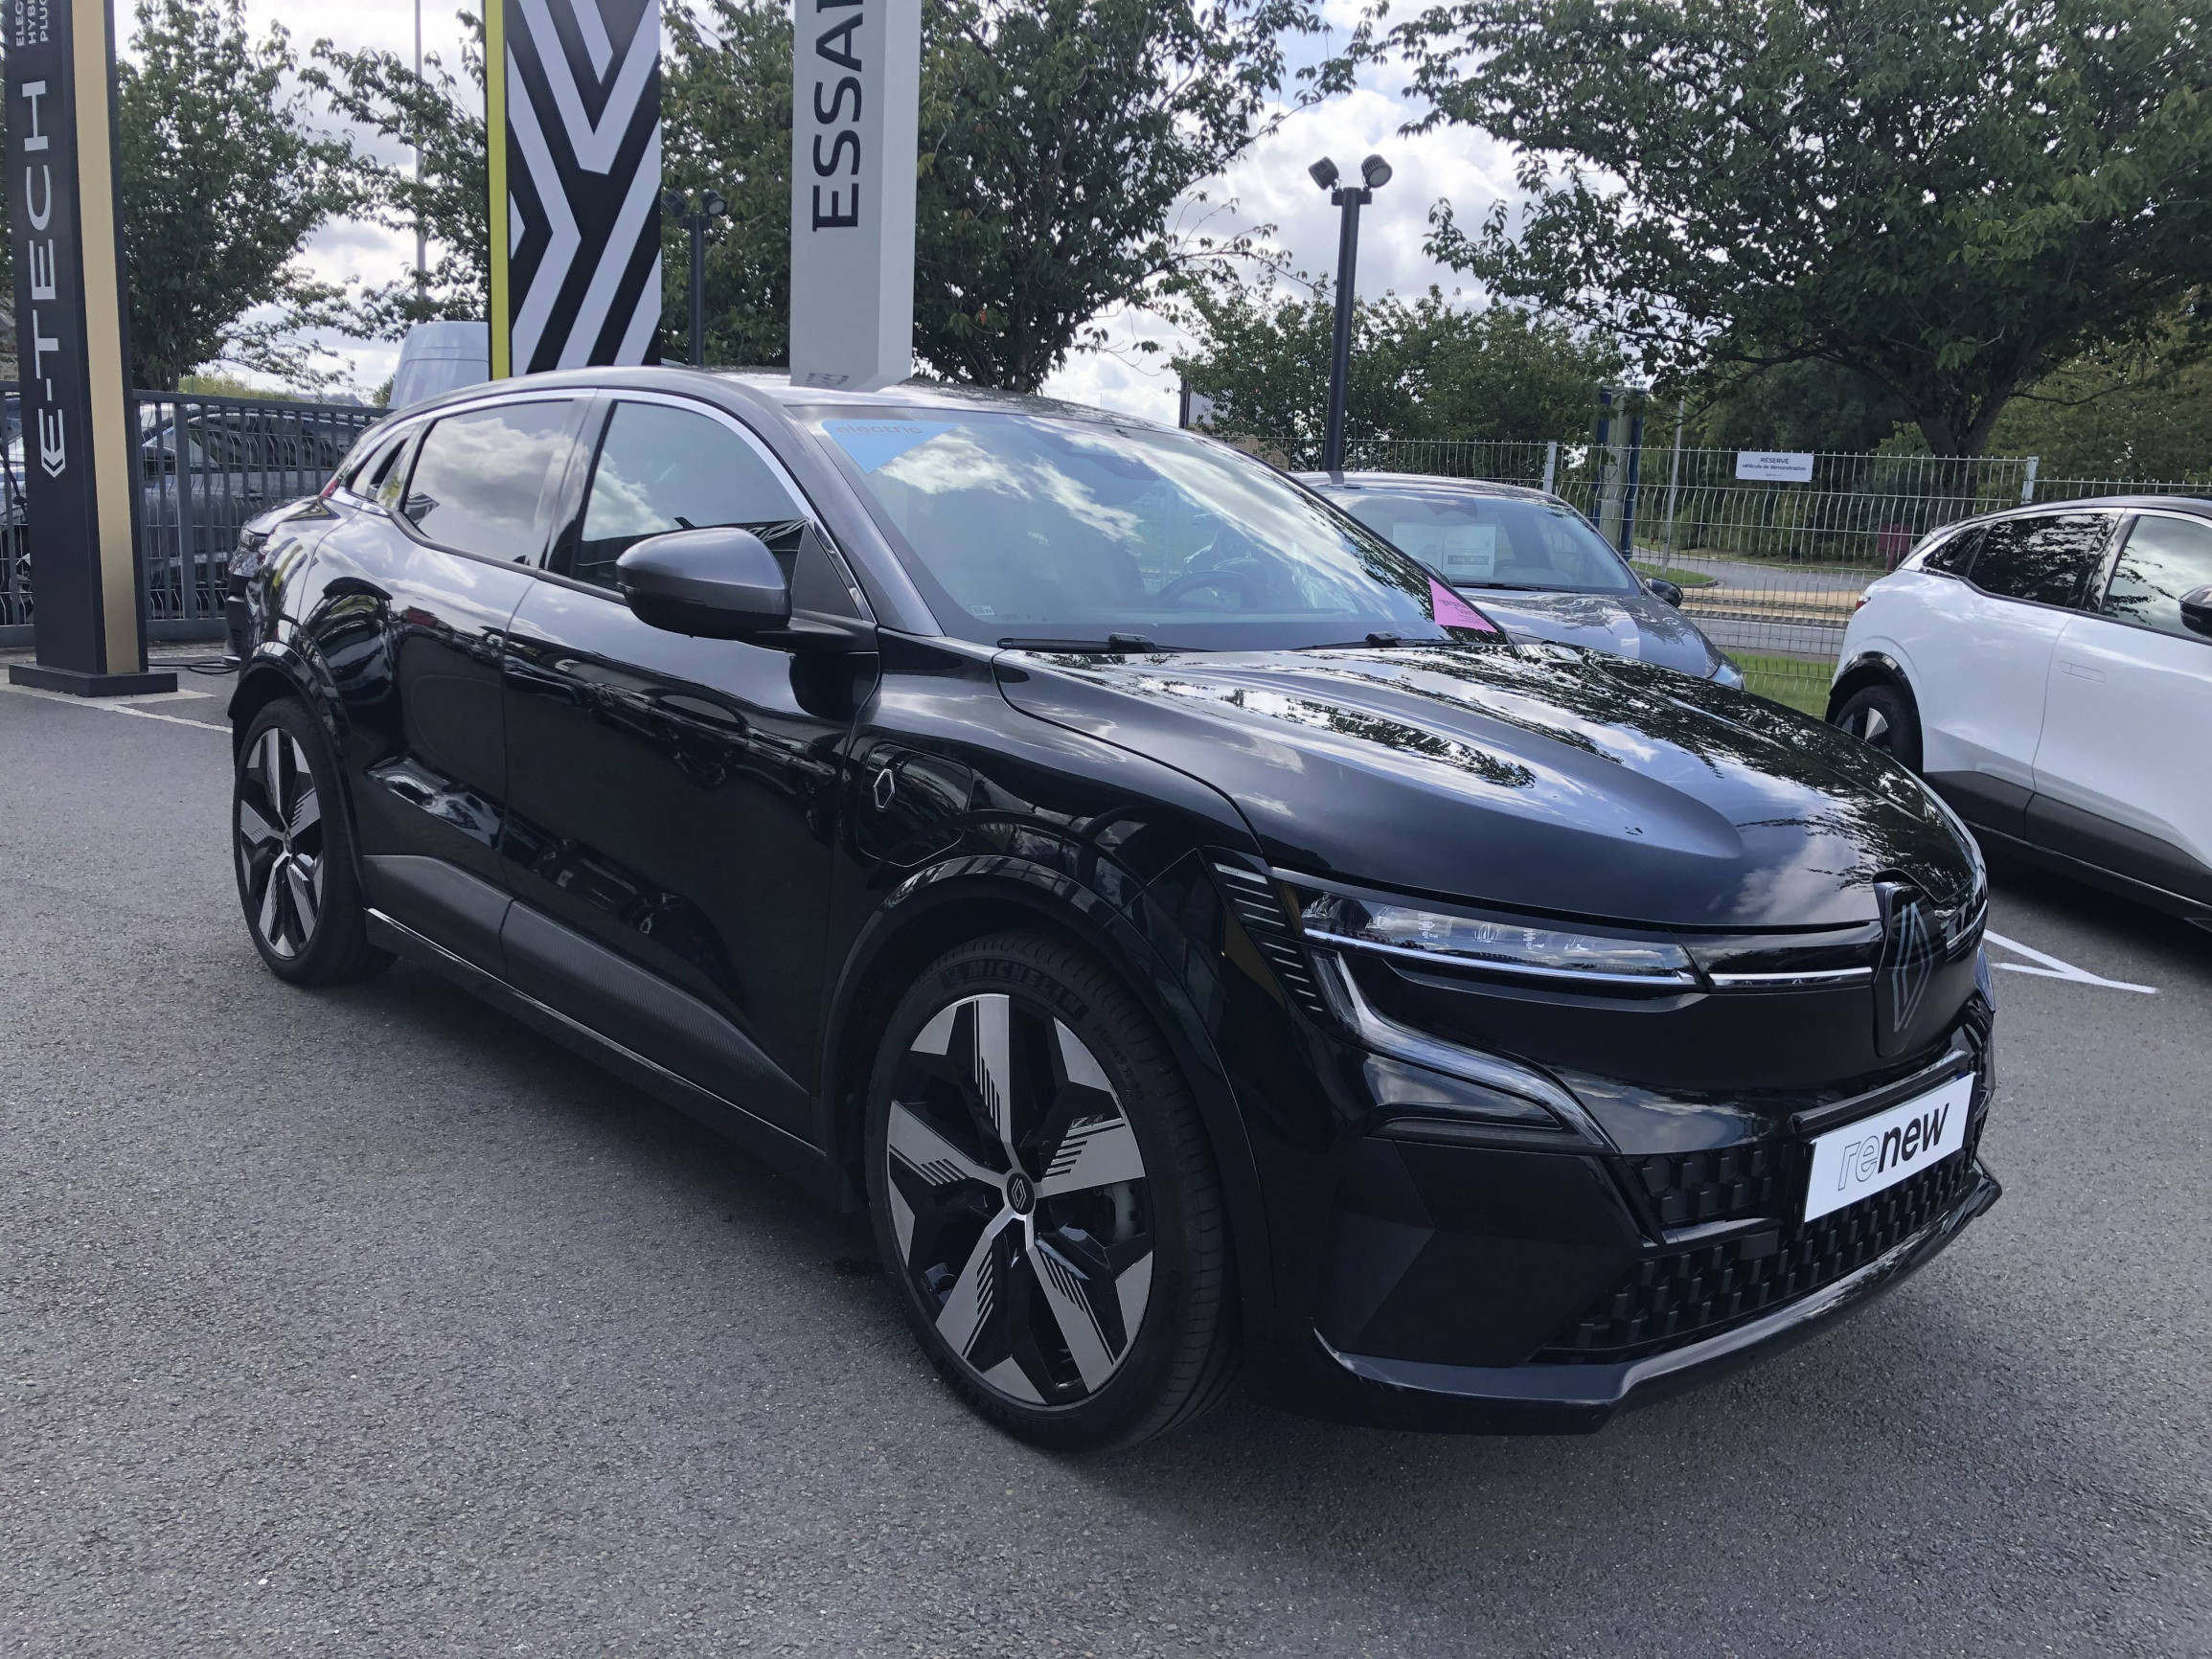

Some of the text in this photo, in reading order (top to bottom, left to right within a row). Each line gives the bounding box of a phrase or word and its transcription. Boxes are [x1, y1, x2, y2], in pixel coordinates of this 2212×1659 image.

[22, 80, 66, 477] E-TECH
[835, 423, 924, 434] electric
[967, 958, 1083, 1017] MICHELIN
[1837, 1102, 1950, 1192] renew
